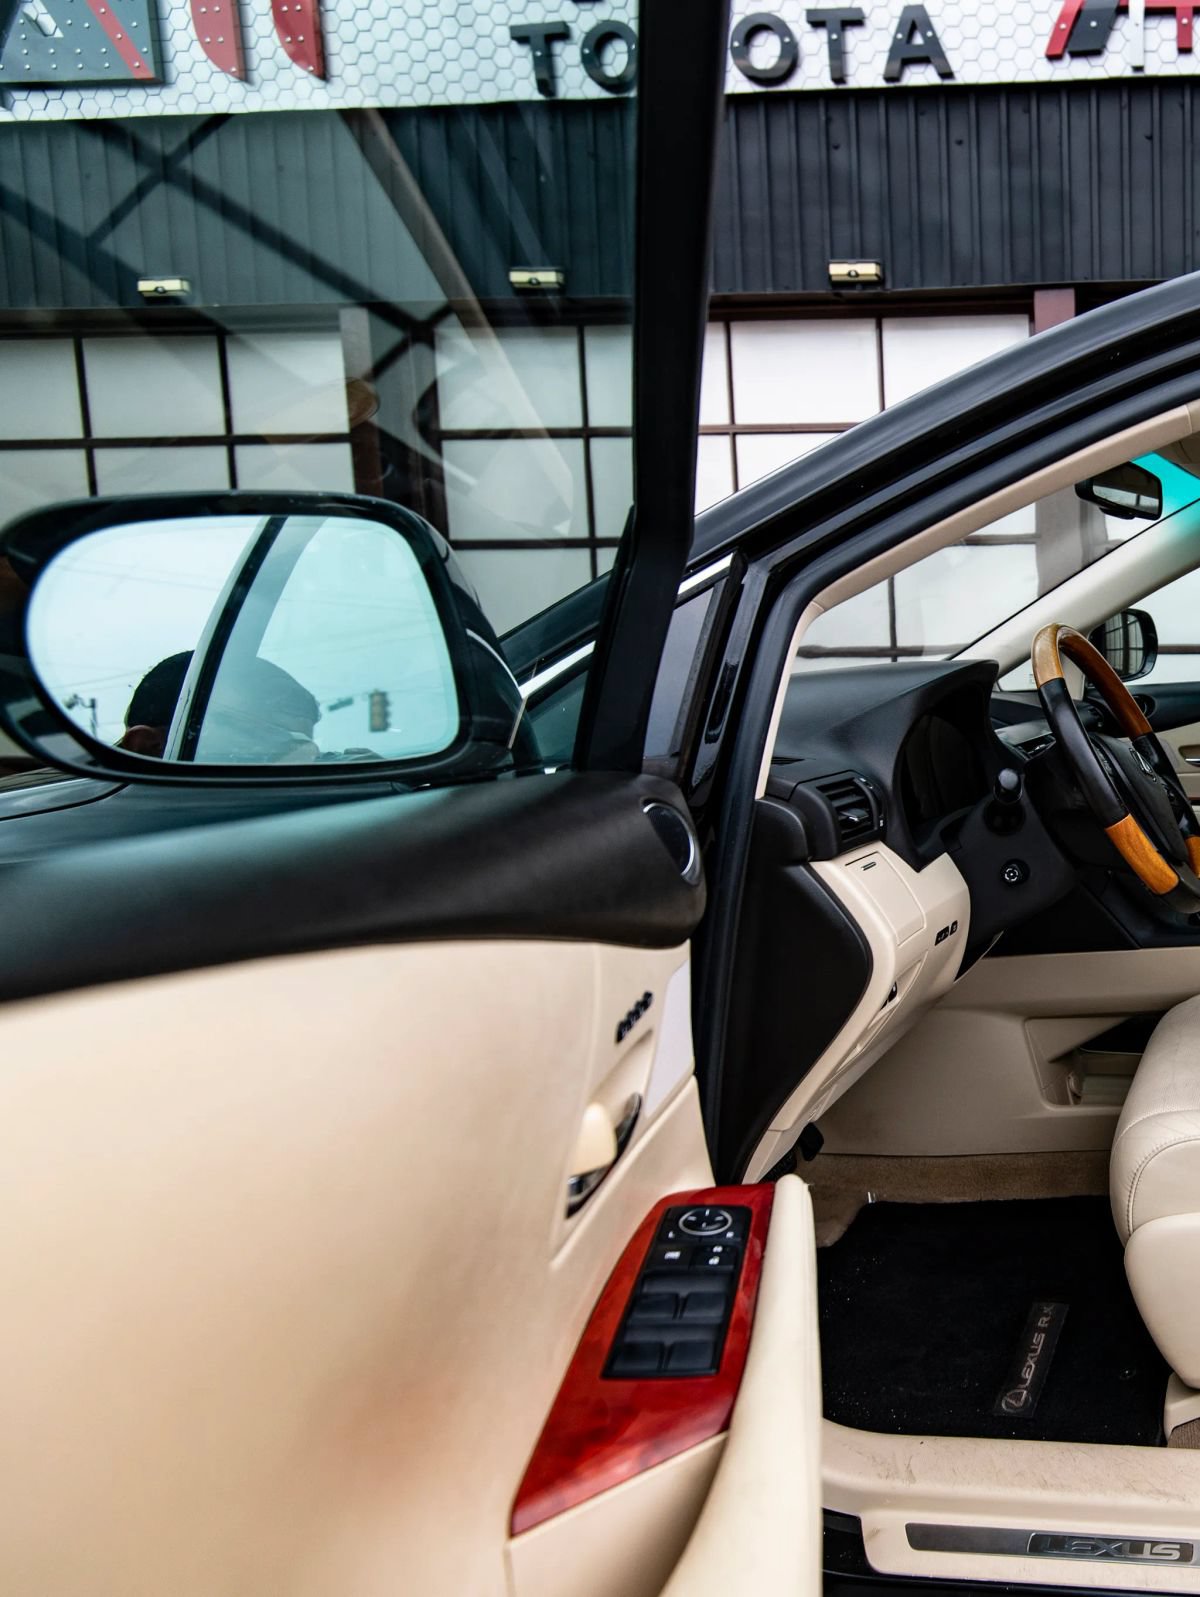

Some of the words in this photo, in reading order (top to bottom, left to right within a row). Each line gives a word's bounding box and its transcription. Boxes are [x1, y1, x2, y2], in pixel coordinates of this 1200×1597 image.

[509, 4, 955, 97] TOOTA
[1016, 1332, 1046, 1390] LEXUS
[1045, 1537, 1181, 1561] LEXUS
